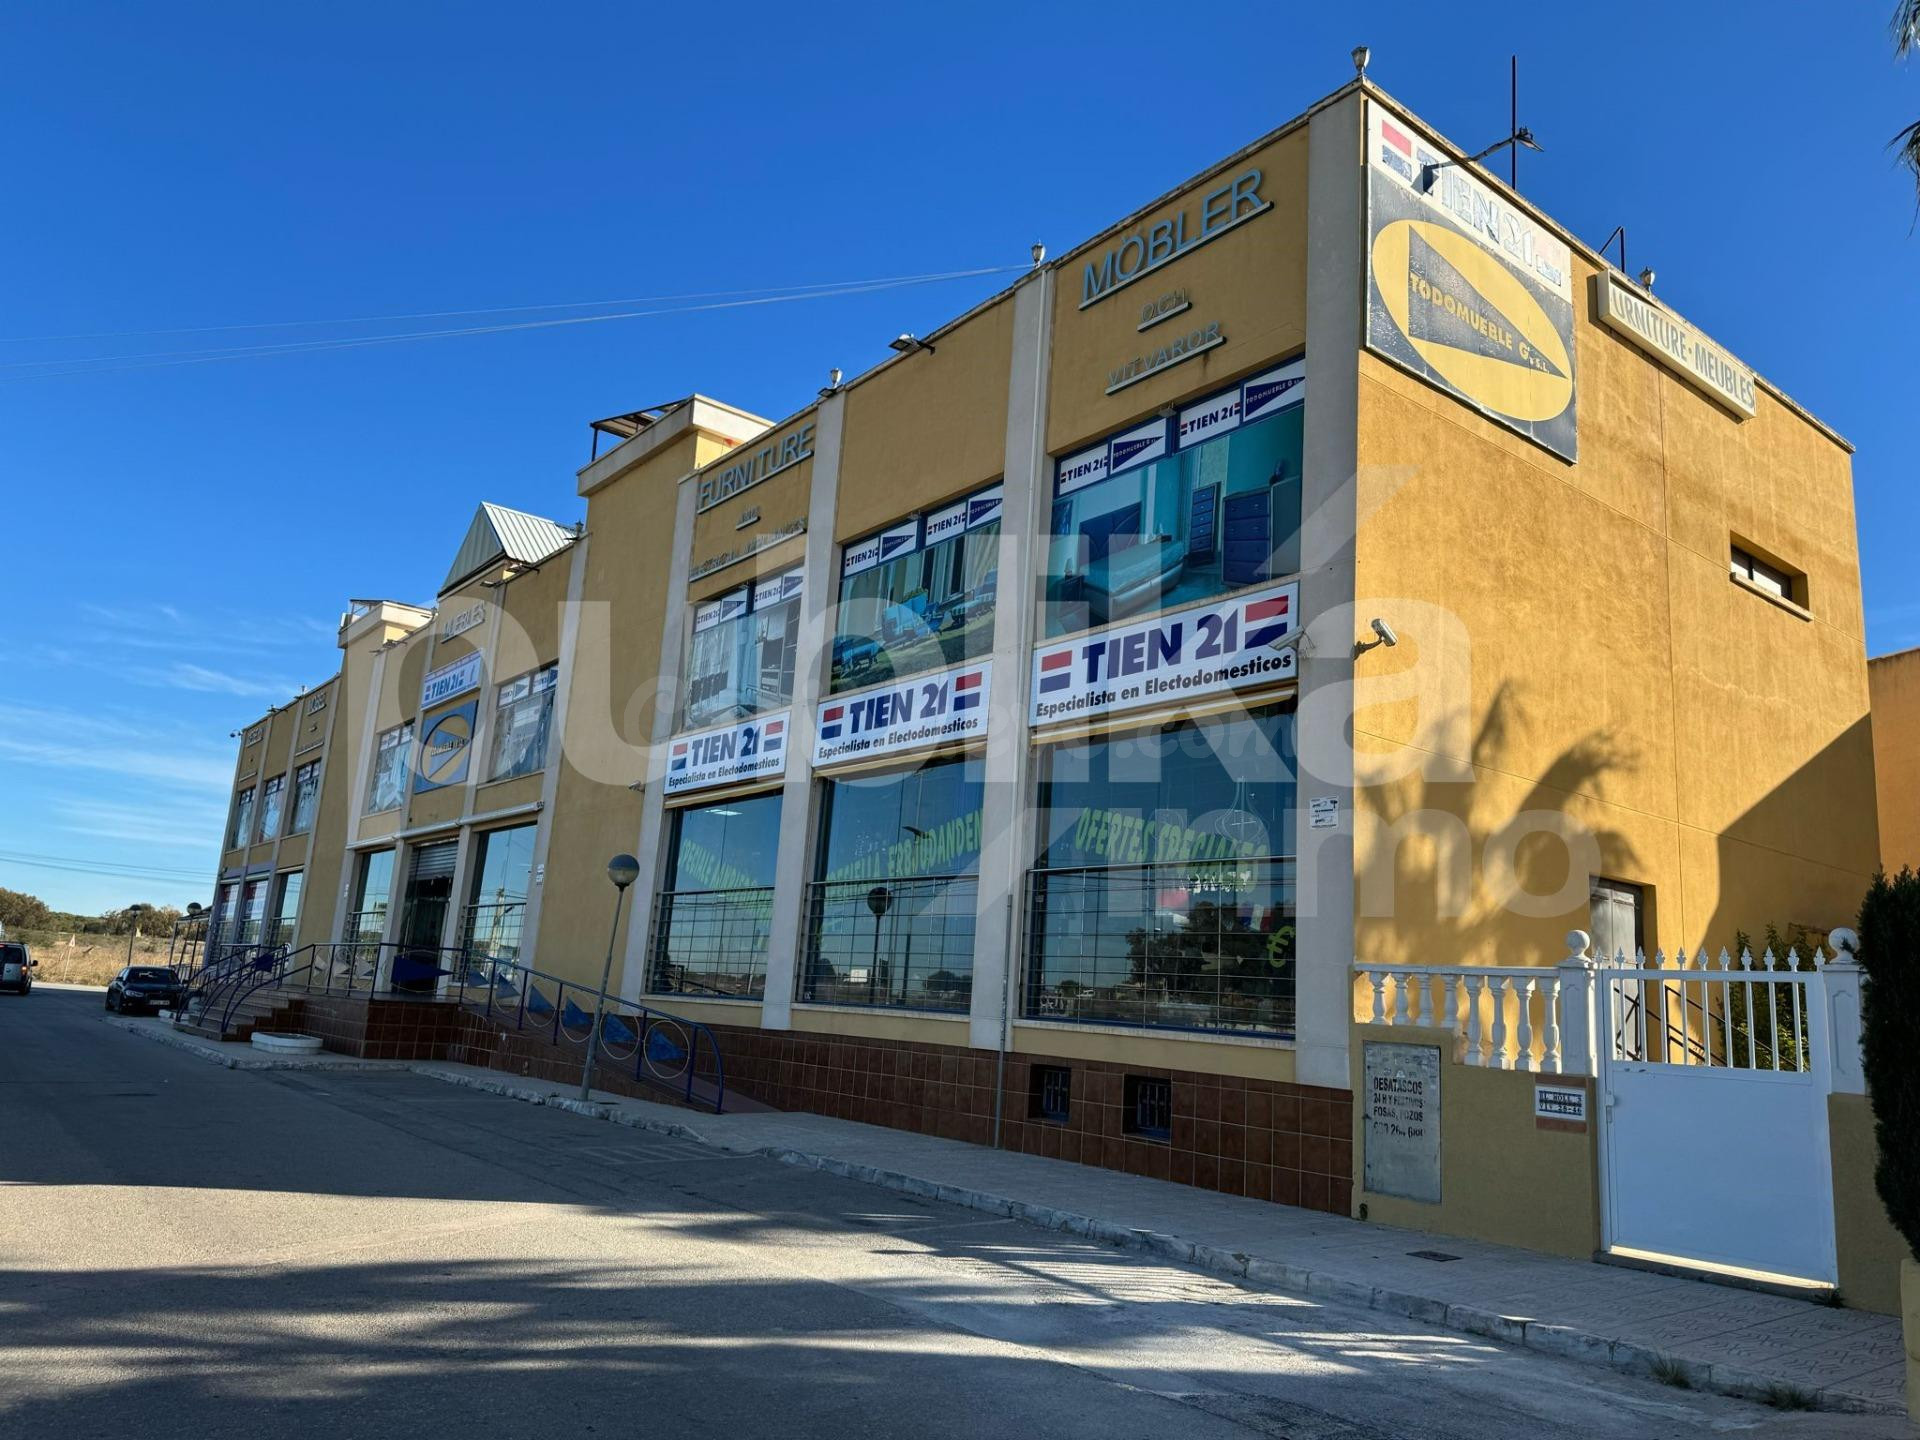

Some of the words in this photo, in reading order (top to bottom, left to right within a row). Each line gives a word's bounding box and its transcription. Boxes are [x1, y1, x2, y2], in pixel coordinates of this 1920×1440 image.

[1081, 168, 1265, 302] MÖBLER
[1410, 272, 1513, 350] TODOMUEBLE
[1694, 341, 1755, 409] MEUBLES
[1188, 410, 1219, 432] TIEN
[699, 422, 816, 507] FURNITURE
[1066, 461, 1092, 481] TIEN
[1082, 622, 1183, 684] TIEN
[1195, 608, 1238, 660] 21
[850, 688, 914, 734] TIEN
[919, 680, 949, 719] 21
[1036, 691, 1116, 718] Especialista
[1121, 685, 1140, 699] en
[1145, 654, 1292, 696] Electodomesticos
[692, 731, 737, 767] TIEN
[740, 725, 760, 757] 21
[818, 739, 870, 759] Especialista
[873, 738, 884, 748] en
[888, 717, 978, 745] Electodomesticos
[669, 772, 706, 788] Especialista
[718, 757, 780, 777] Electodomesticos
[1373, 1077, 1423, 1095] DESATASCOS
